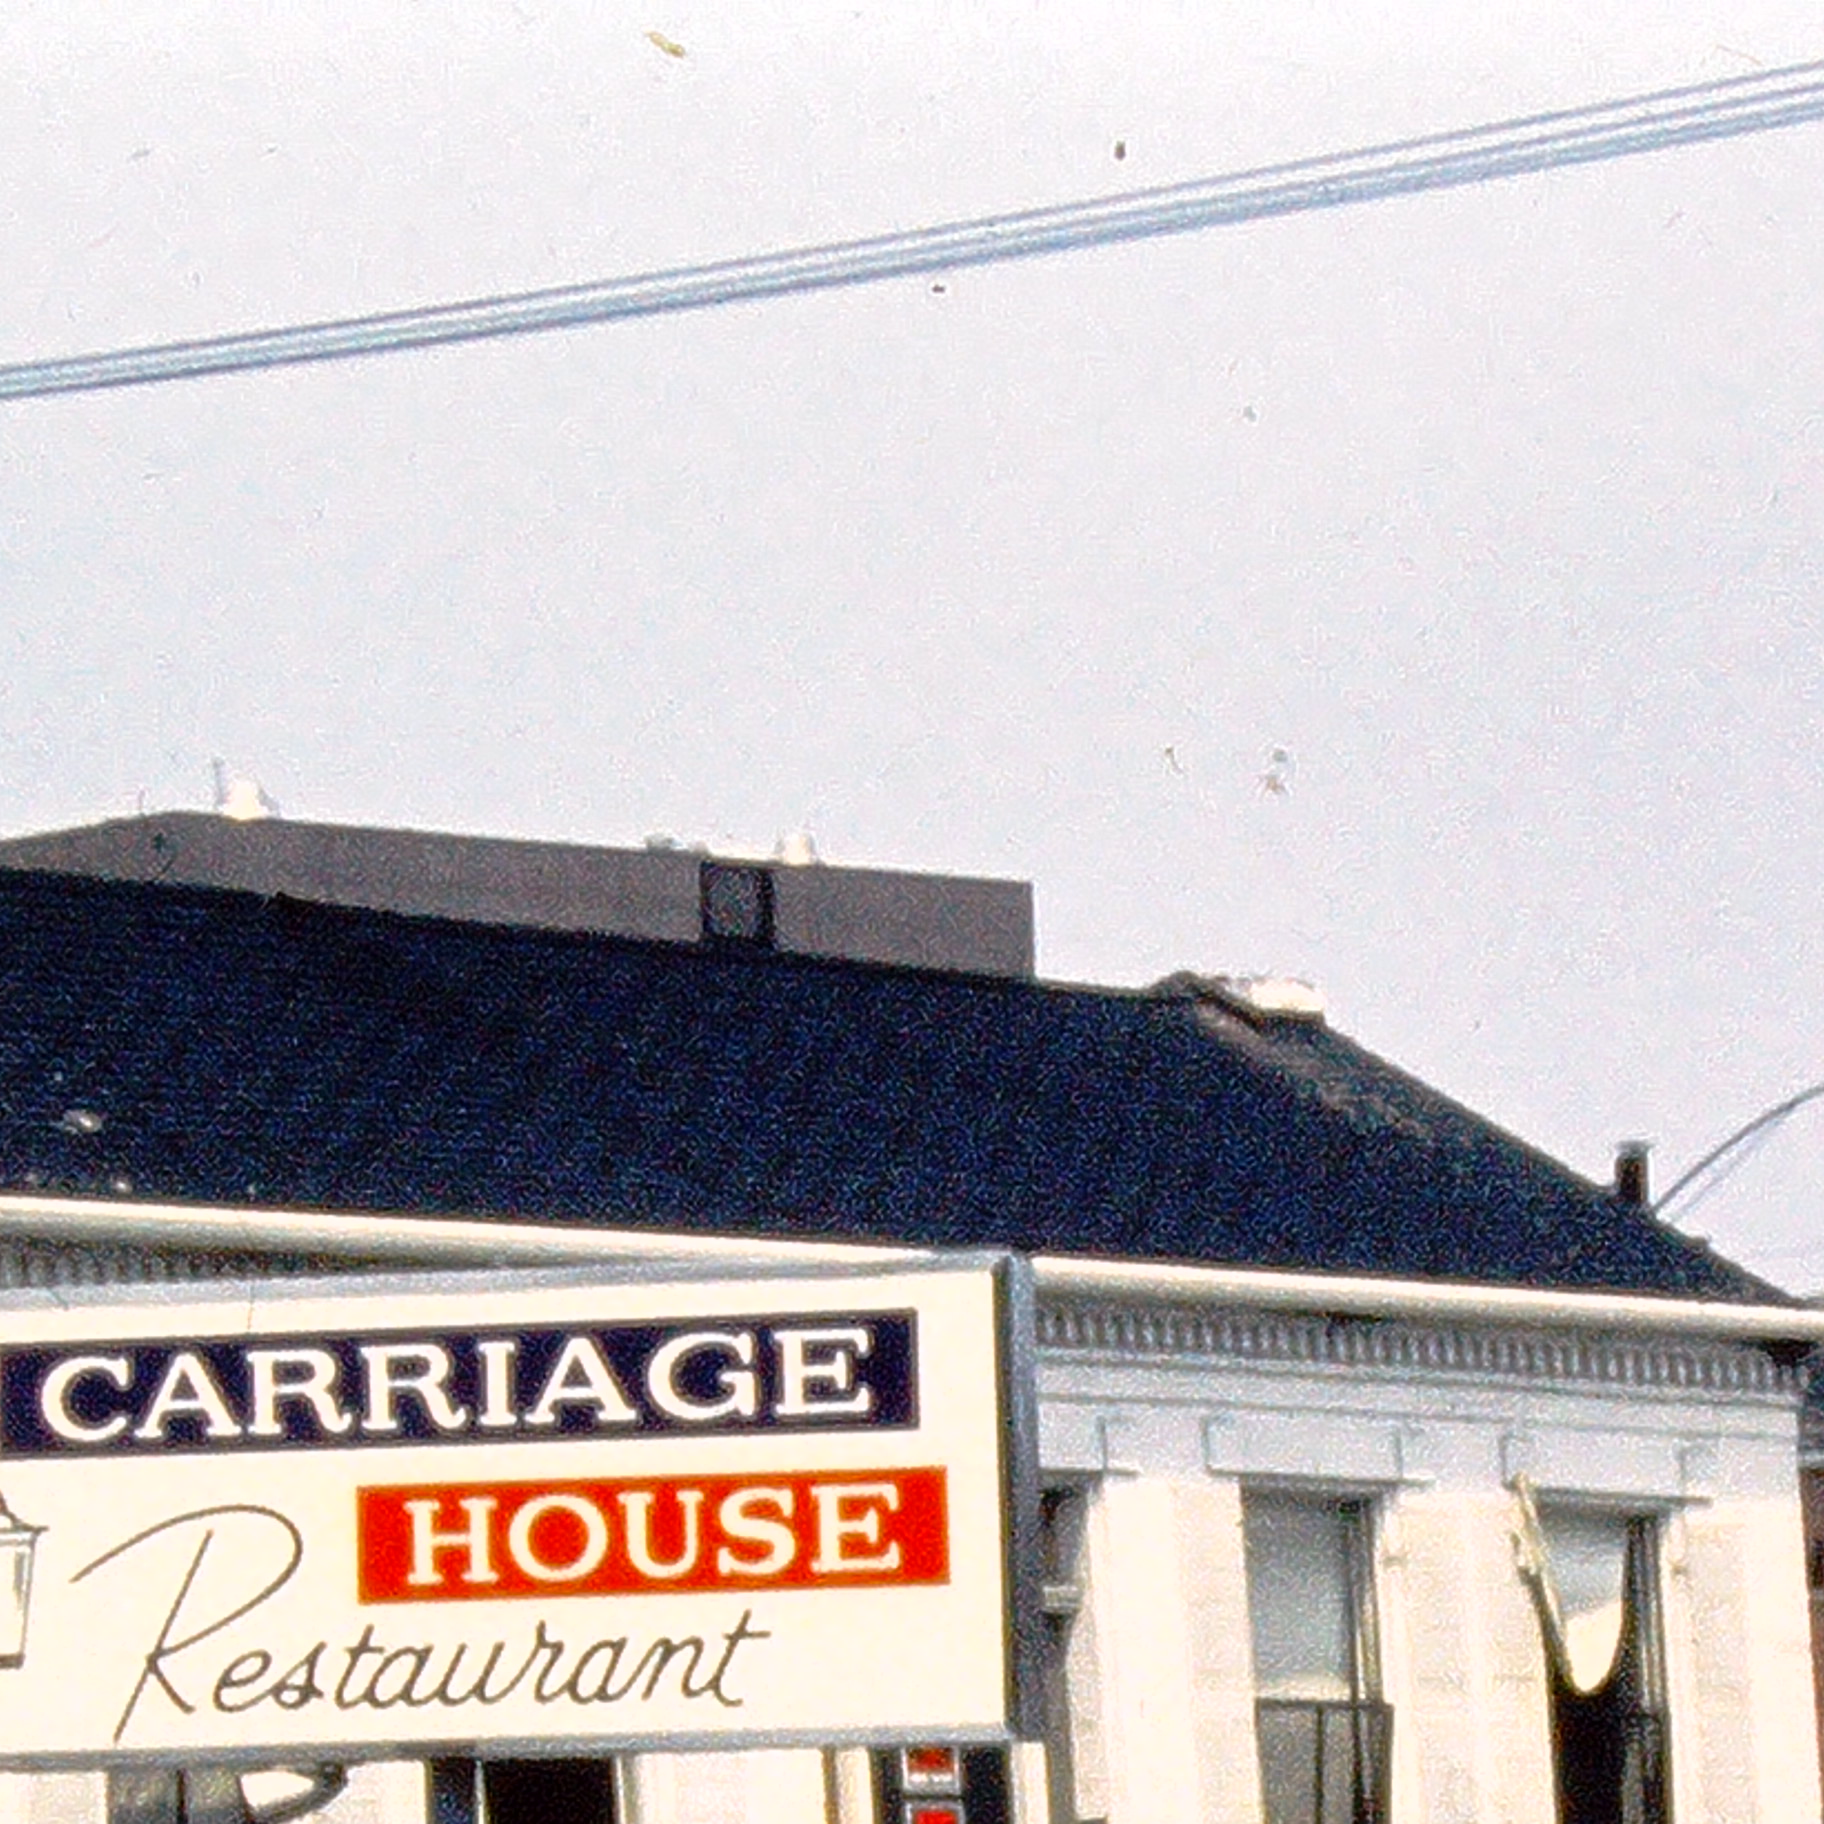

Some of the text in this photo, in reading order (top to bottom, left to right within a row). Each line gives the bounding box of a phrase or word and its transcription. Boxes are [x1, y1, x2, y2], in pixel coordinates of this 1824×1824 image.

[36, 1320, 876, 1444] CARRIAGE
[402, 1482, 903, 1588] HOUSE
[68, 1501, 772, 1747] Restaurant
